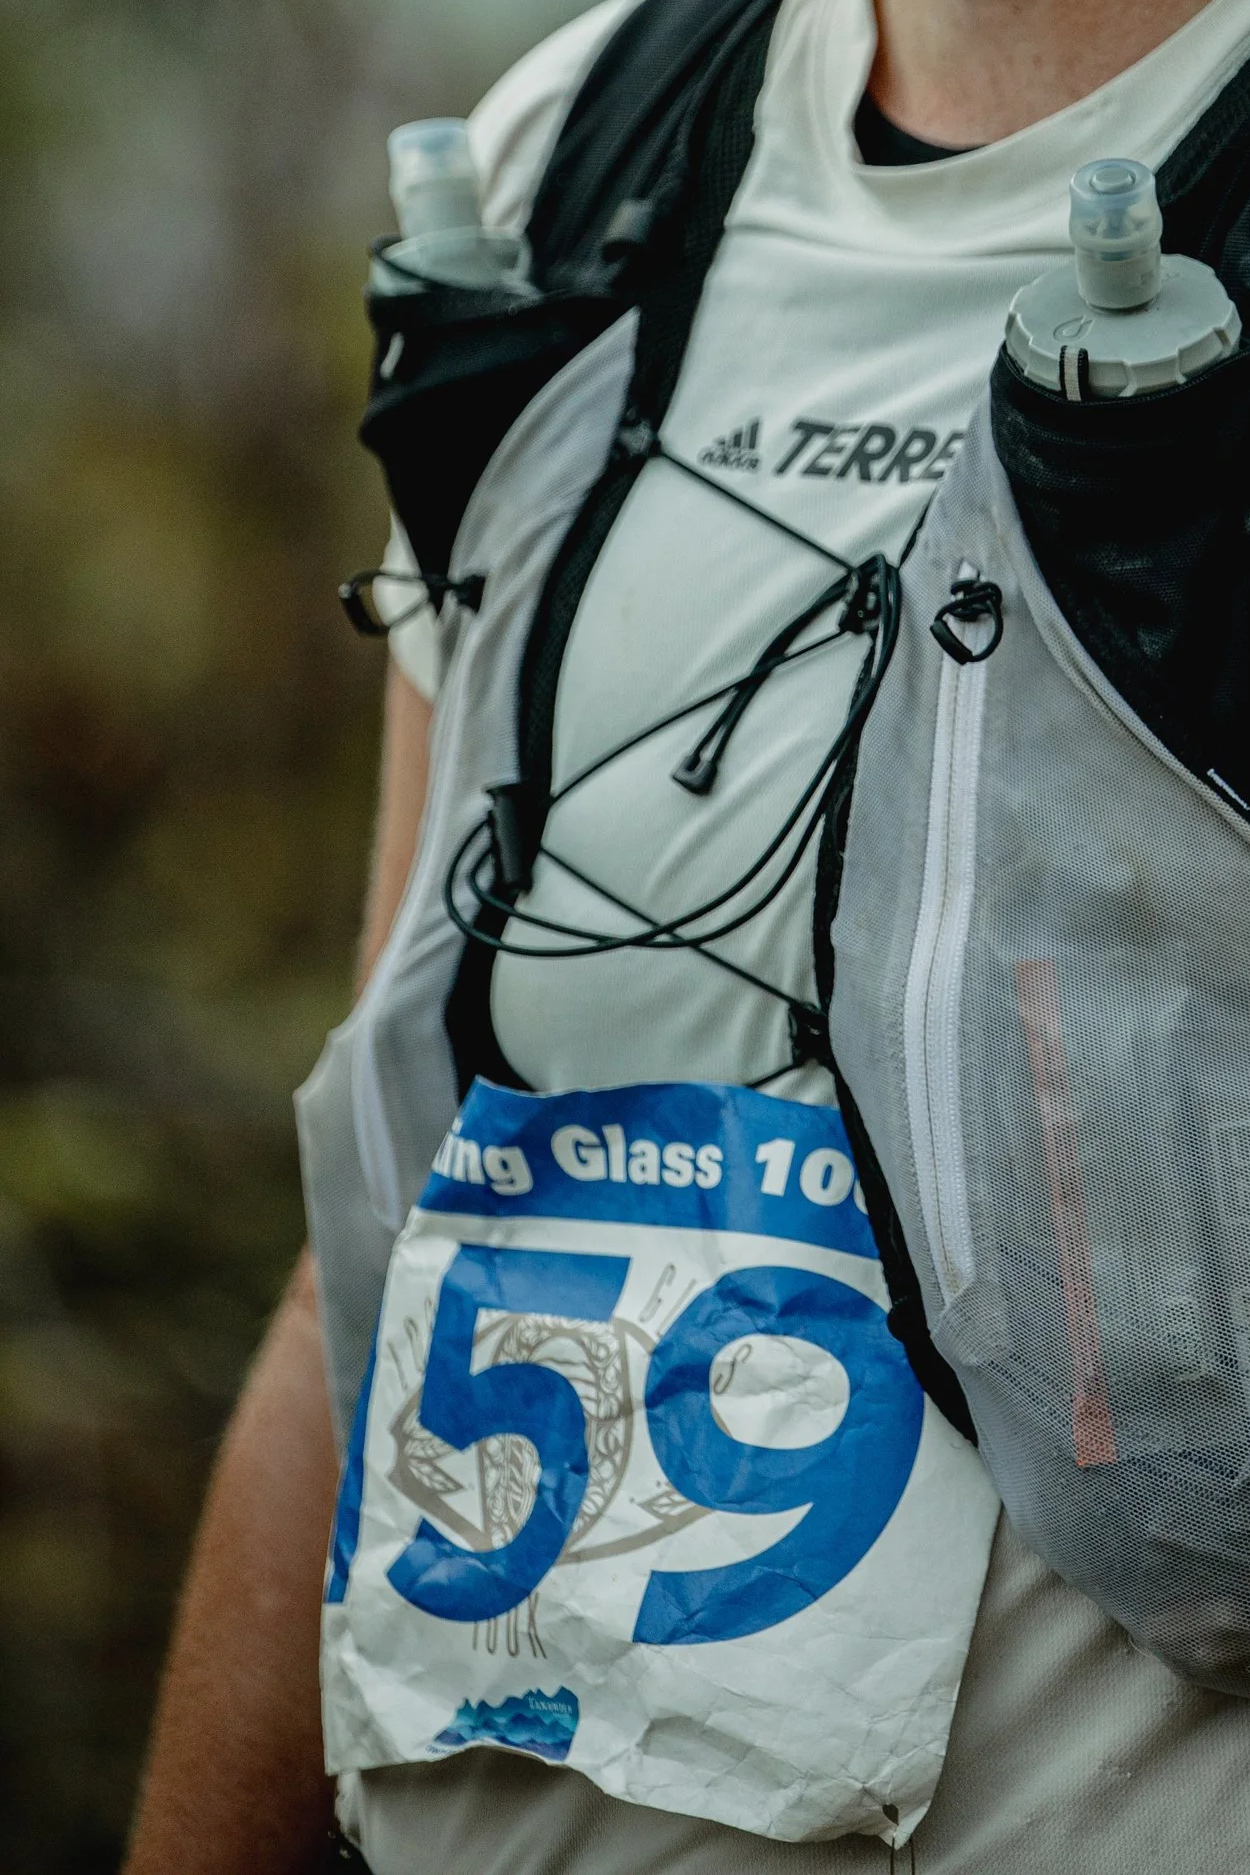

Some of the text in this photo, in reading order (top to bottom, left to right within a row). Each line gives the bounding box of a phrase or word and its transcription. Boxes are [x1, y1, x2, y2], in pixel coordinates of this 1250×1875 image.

[431, 1116, 870, 1216] ing Glass 10
